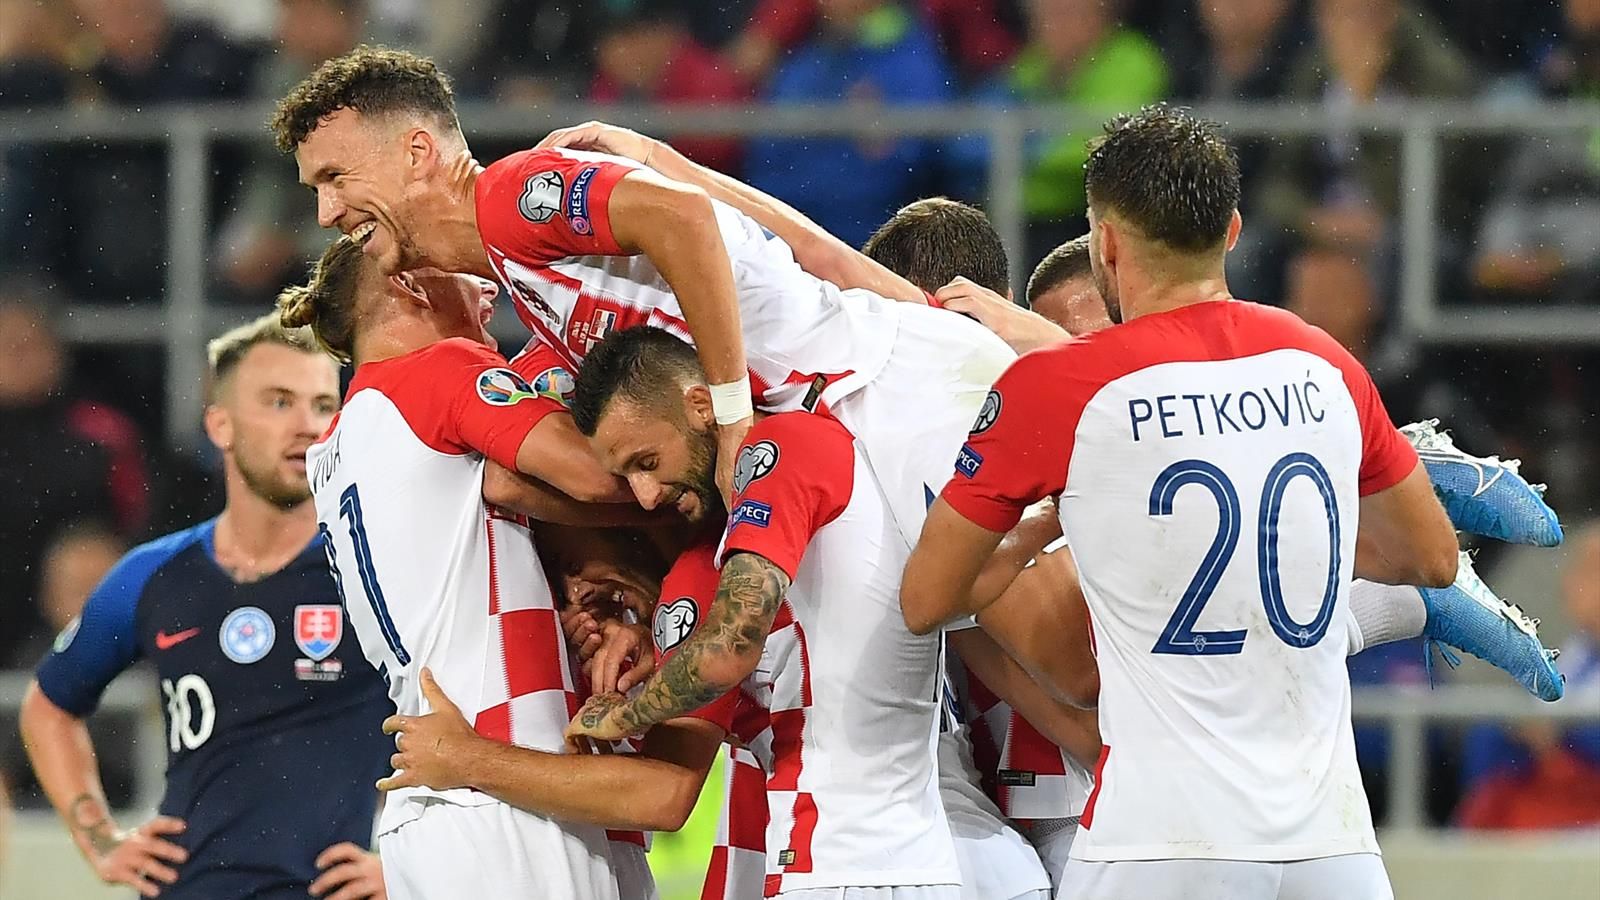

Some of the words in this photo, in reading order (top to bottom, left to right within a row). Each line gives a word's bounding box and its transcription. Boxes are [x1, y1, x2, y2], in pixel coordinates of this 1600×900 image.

[572, 167, 594, 216] RESPECT
[1128, 369, 1325, 441] PETKOVIĆ
[1148, 452, 1341, 656] 20
[161, 674, 216, 752] 10
